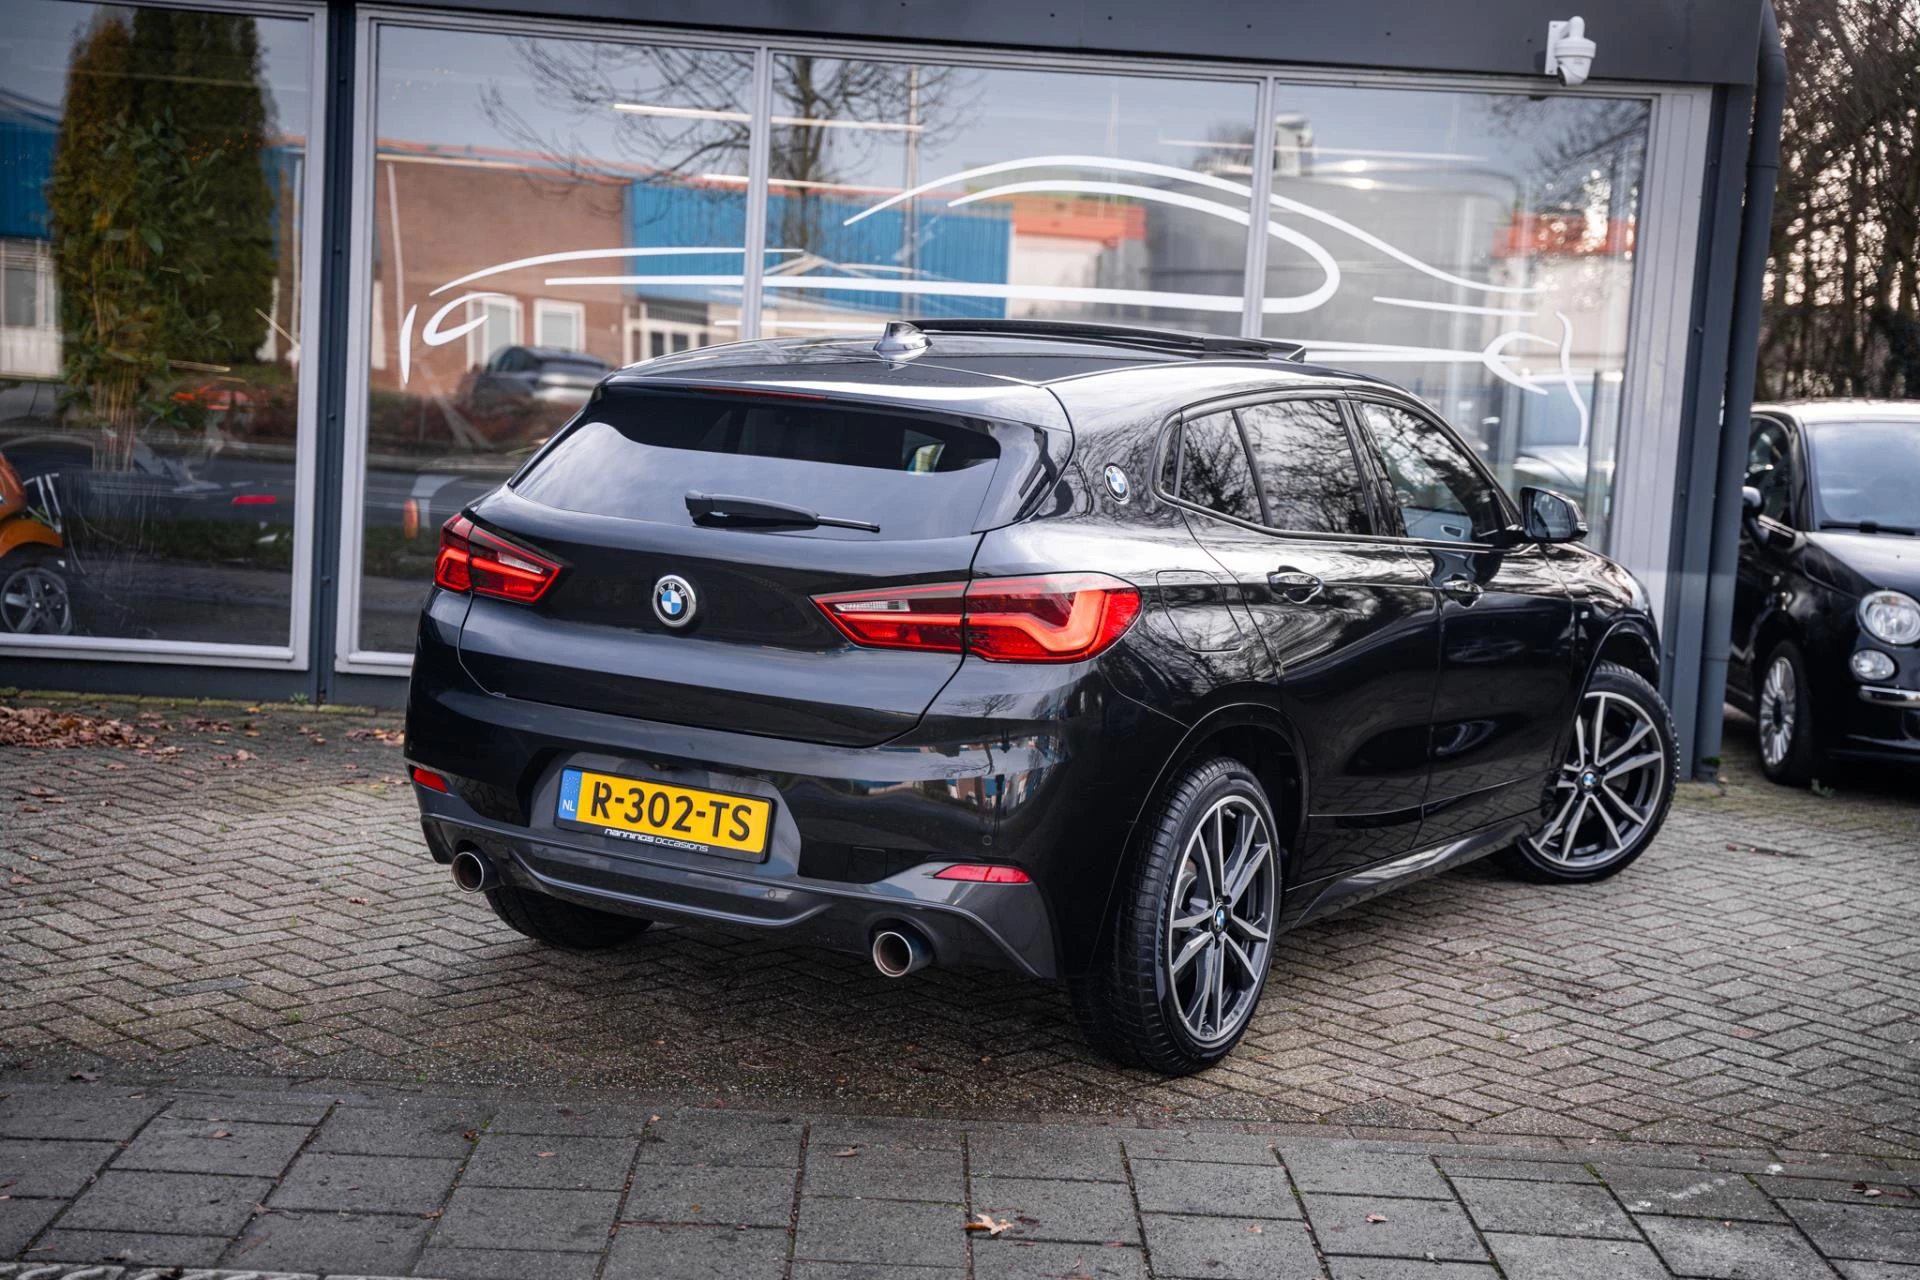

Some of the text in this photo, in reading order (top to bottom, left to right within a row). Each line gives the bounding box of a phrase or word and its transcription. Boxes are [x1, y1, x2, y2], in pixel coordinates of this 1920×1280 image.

[659, 582, 687, 597] BMW
[562, 799, 575, 812] NL
[591, 781, 752, 842] R-302-TS
[655, 837, 709, 852] occasions
